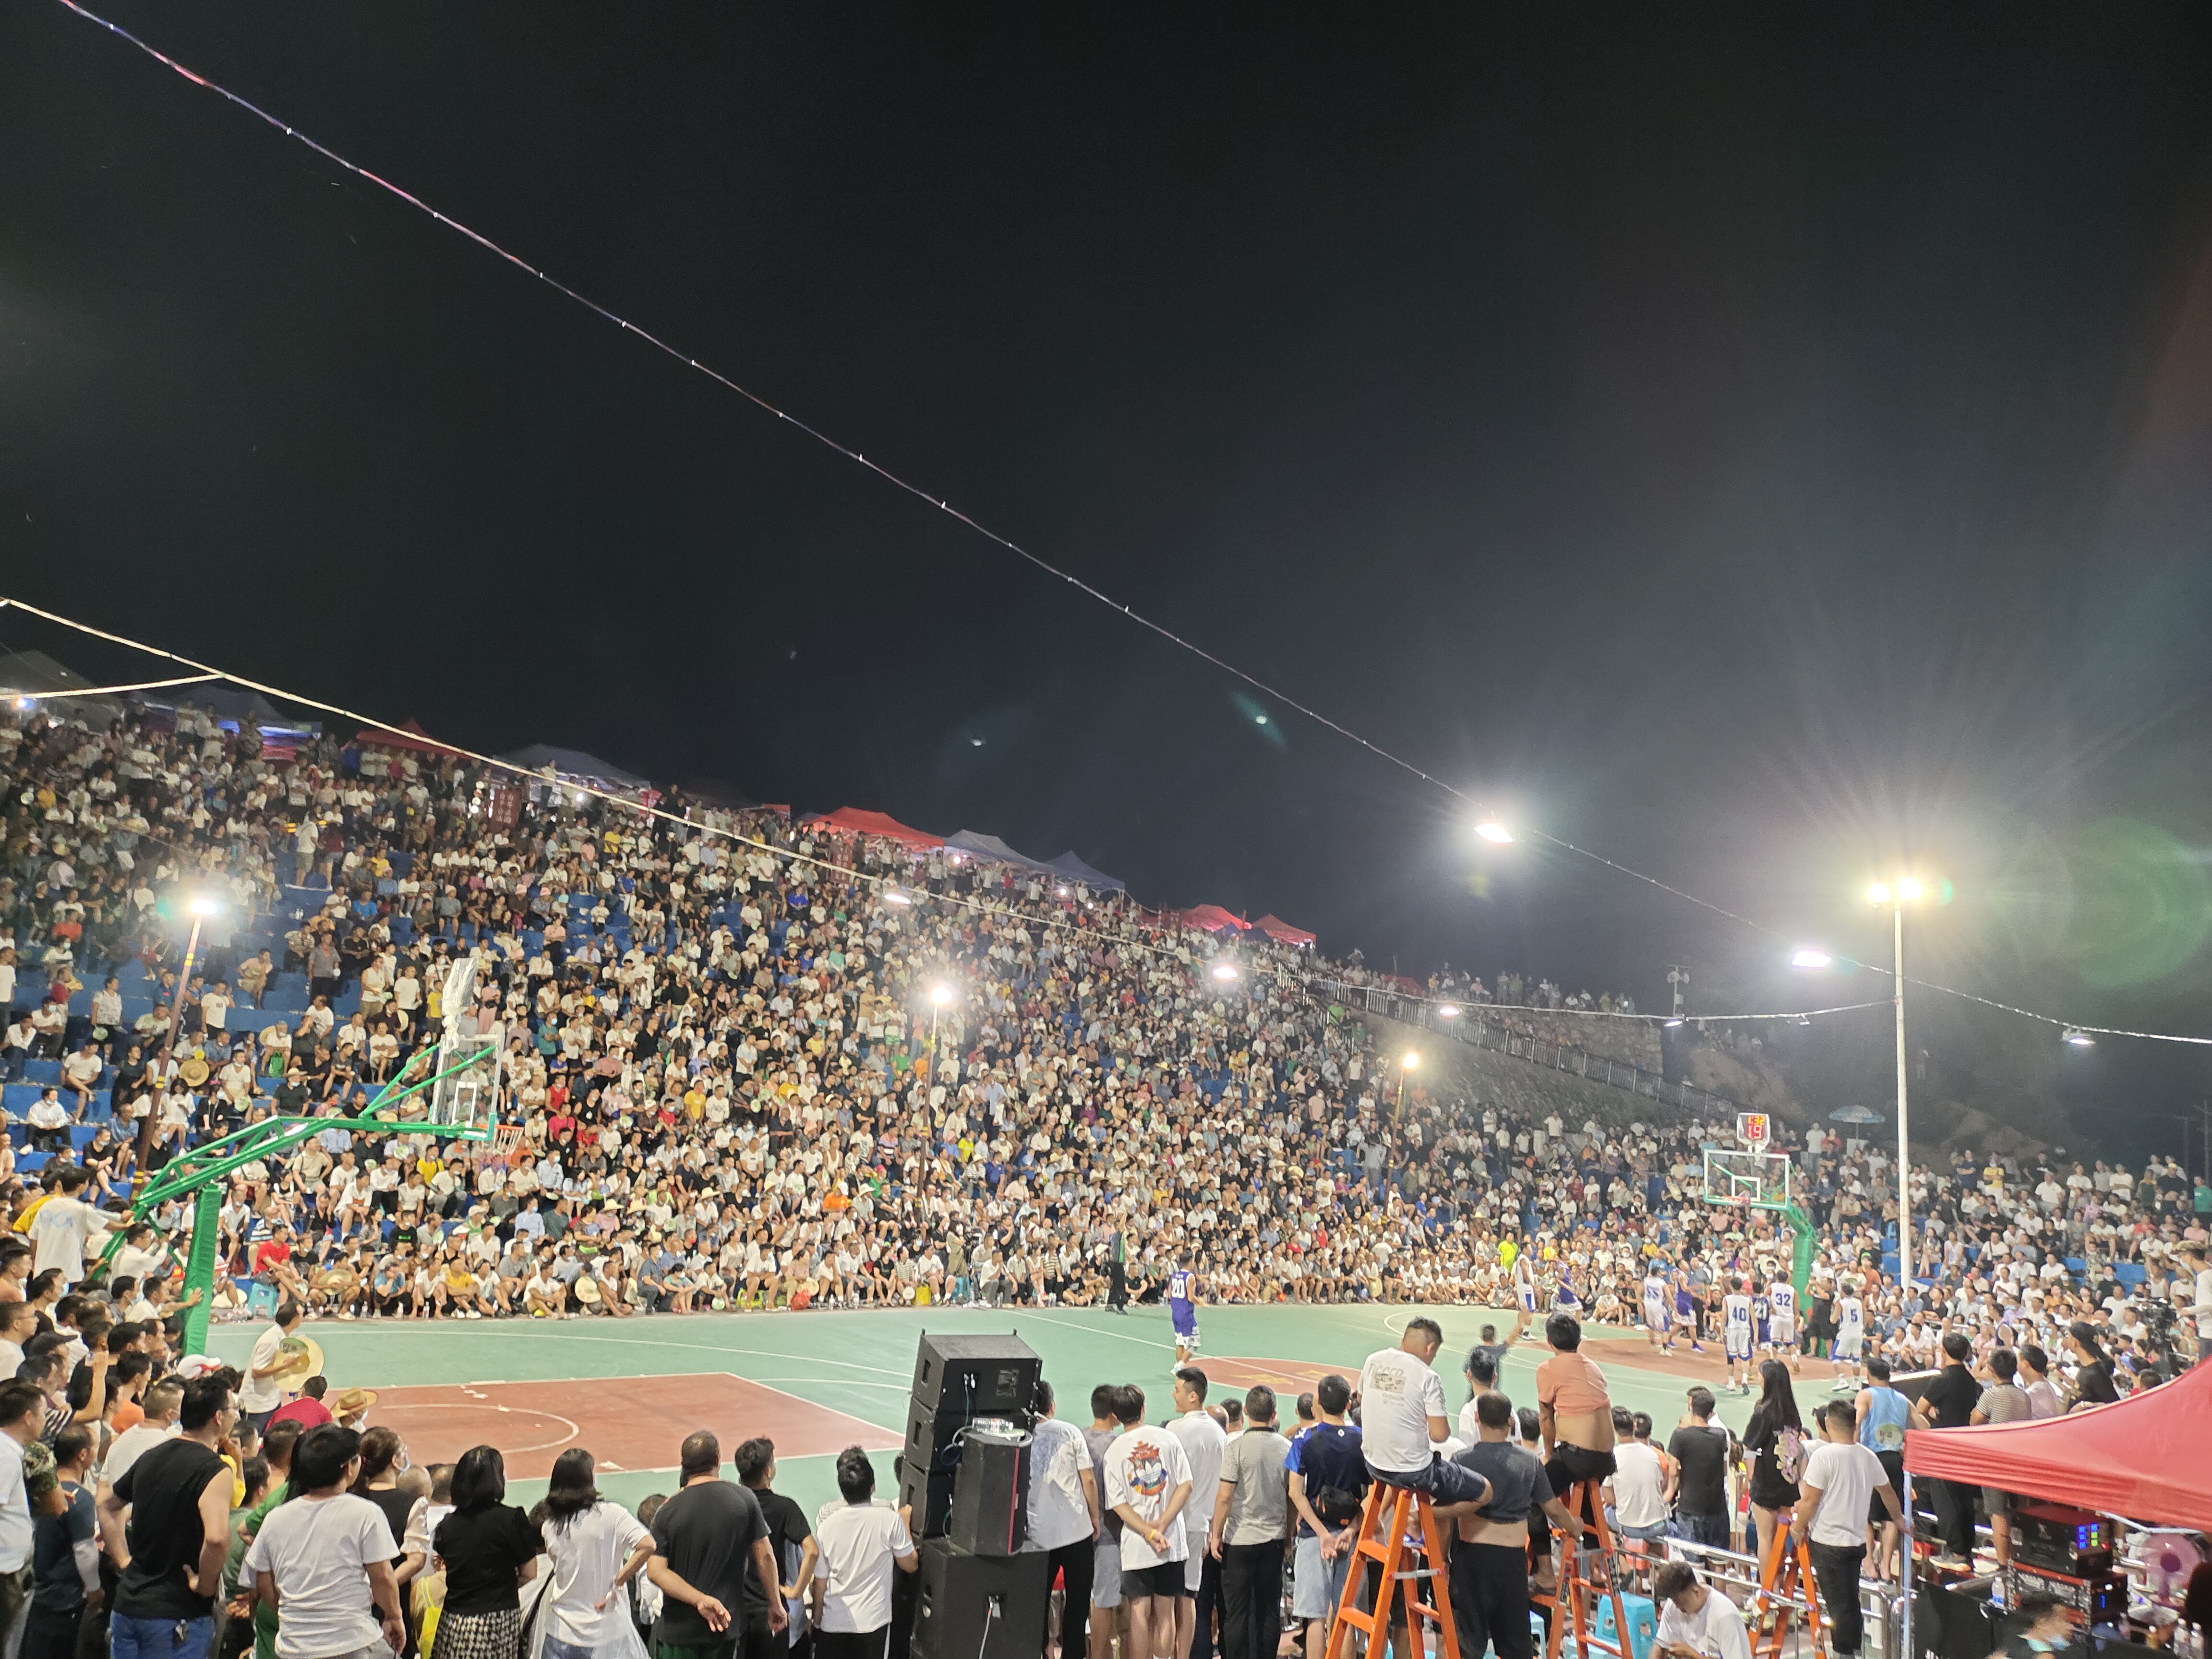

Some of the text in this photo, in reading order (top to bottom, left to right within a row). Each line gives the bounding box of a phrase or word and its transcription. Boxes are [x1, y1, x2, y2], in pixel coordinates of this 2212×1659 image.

[1748, 1115, 1766, 1126] 1:32
[1747, 1125, 1762, 1140] 19
[1171, 1278, 1185, 1298] 20
[1776, 1293, 1791, 1307] 32
[1732, 1307, 1747, 1322] 40
[1755, 1302, 1768, 1320] 21
[1851, 1309, 1858, 1322] 5
